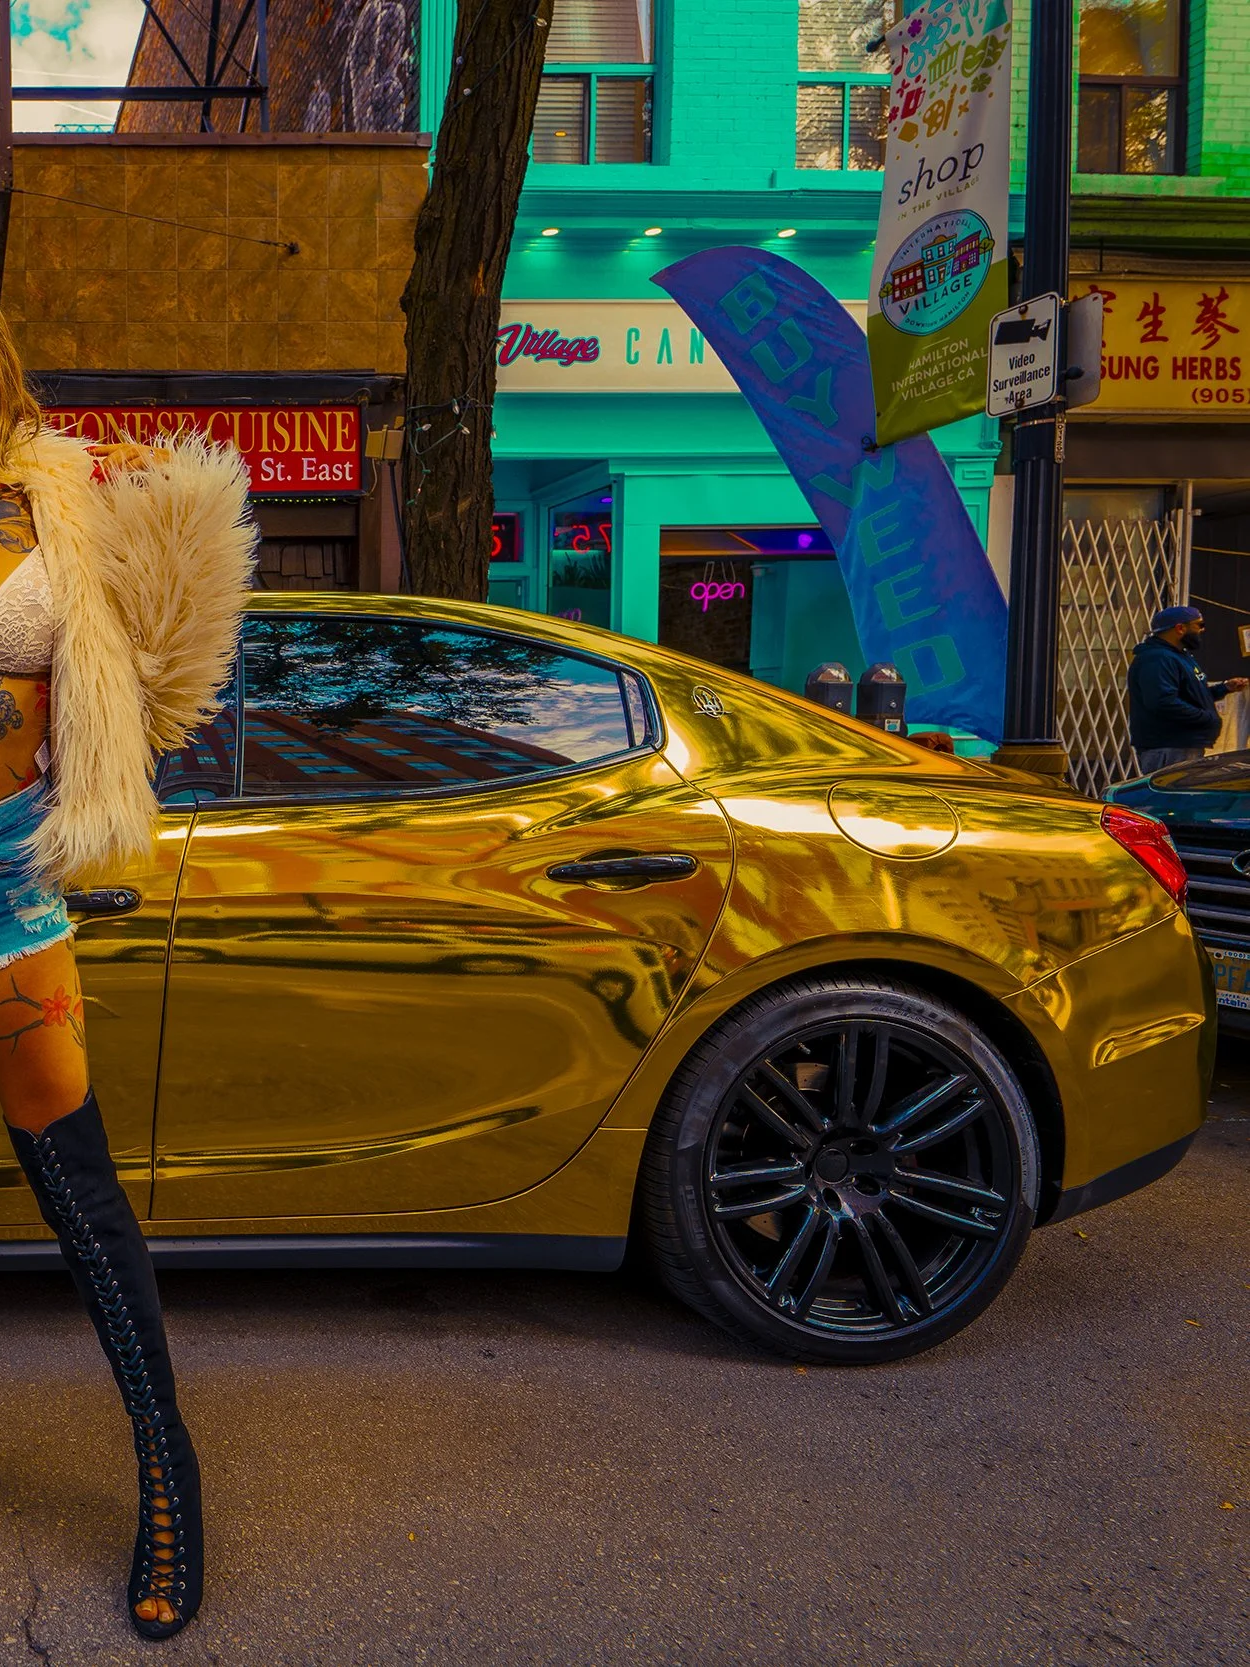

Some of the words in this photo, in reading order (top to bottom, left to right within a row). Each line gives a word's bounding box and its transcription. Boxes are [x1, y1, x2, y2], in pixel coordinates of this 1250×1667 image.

[897, 142, 984, 206] shop
[911, 199, 931, 213] THE
[935, 173, 980, 201] VILLAGE
[898, 272, 973, 316] VILLAGE
[496, 321, 601, 367] Village
[908, 337, 969, 372] HAMILTON
[1008, 352, 1036, 370] Video
[891, 346, 988, 393] INTERNATIONAL
[901, 366, 975, 401] VILLAGE.CA
[992, 365, 1051, 393] Surveillance
[1171, 355, 1242, 381] HERBS
[1008, 387, 1032, 404] Area
[44, 410, 197, 447] TONESE
[206, 410, 357, 454] CUISINE
[260, 457, 292, 482] St.
[301, 457, 354, 482] East
[718, 271, 839, 429] BUY
[808, 446, 967, 701] WEED
[690, 581, 745, 613] open
[1217, 997, 1247, 1008] ntain
